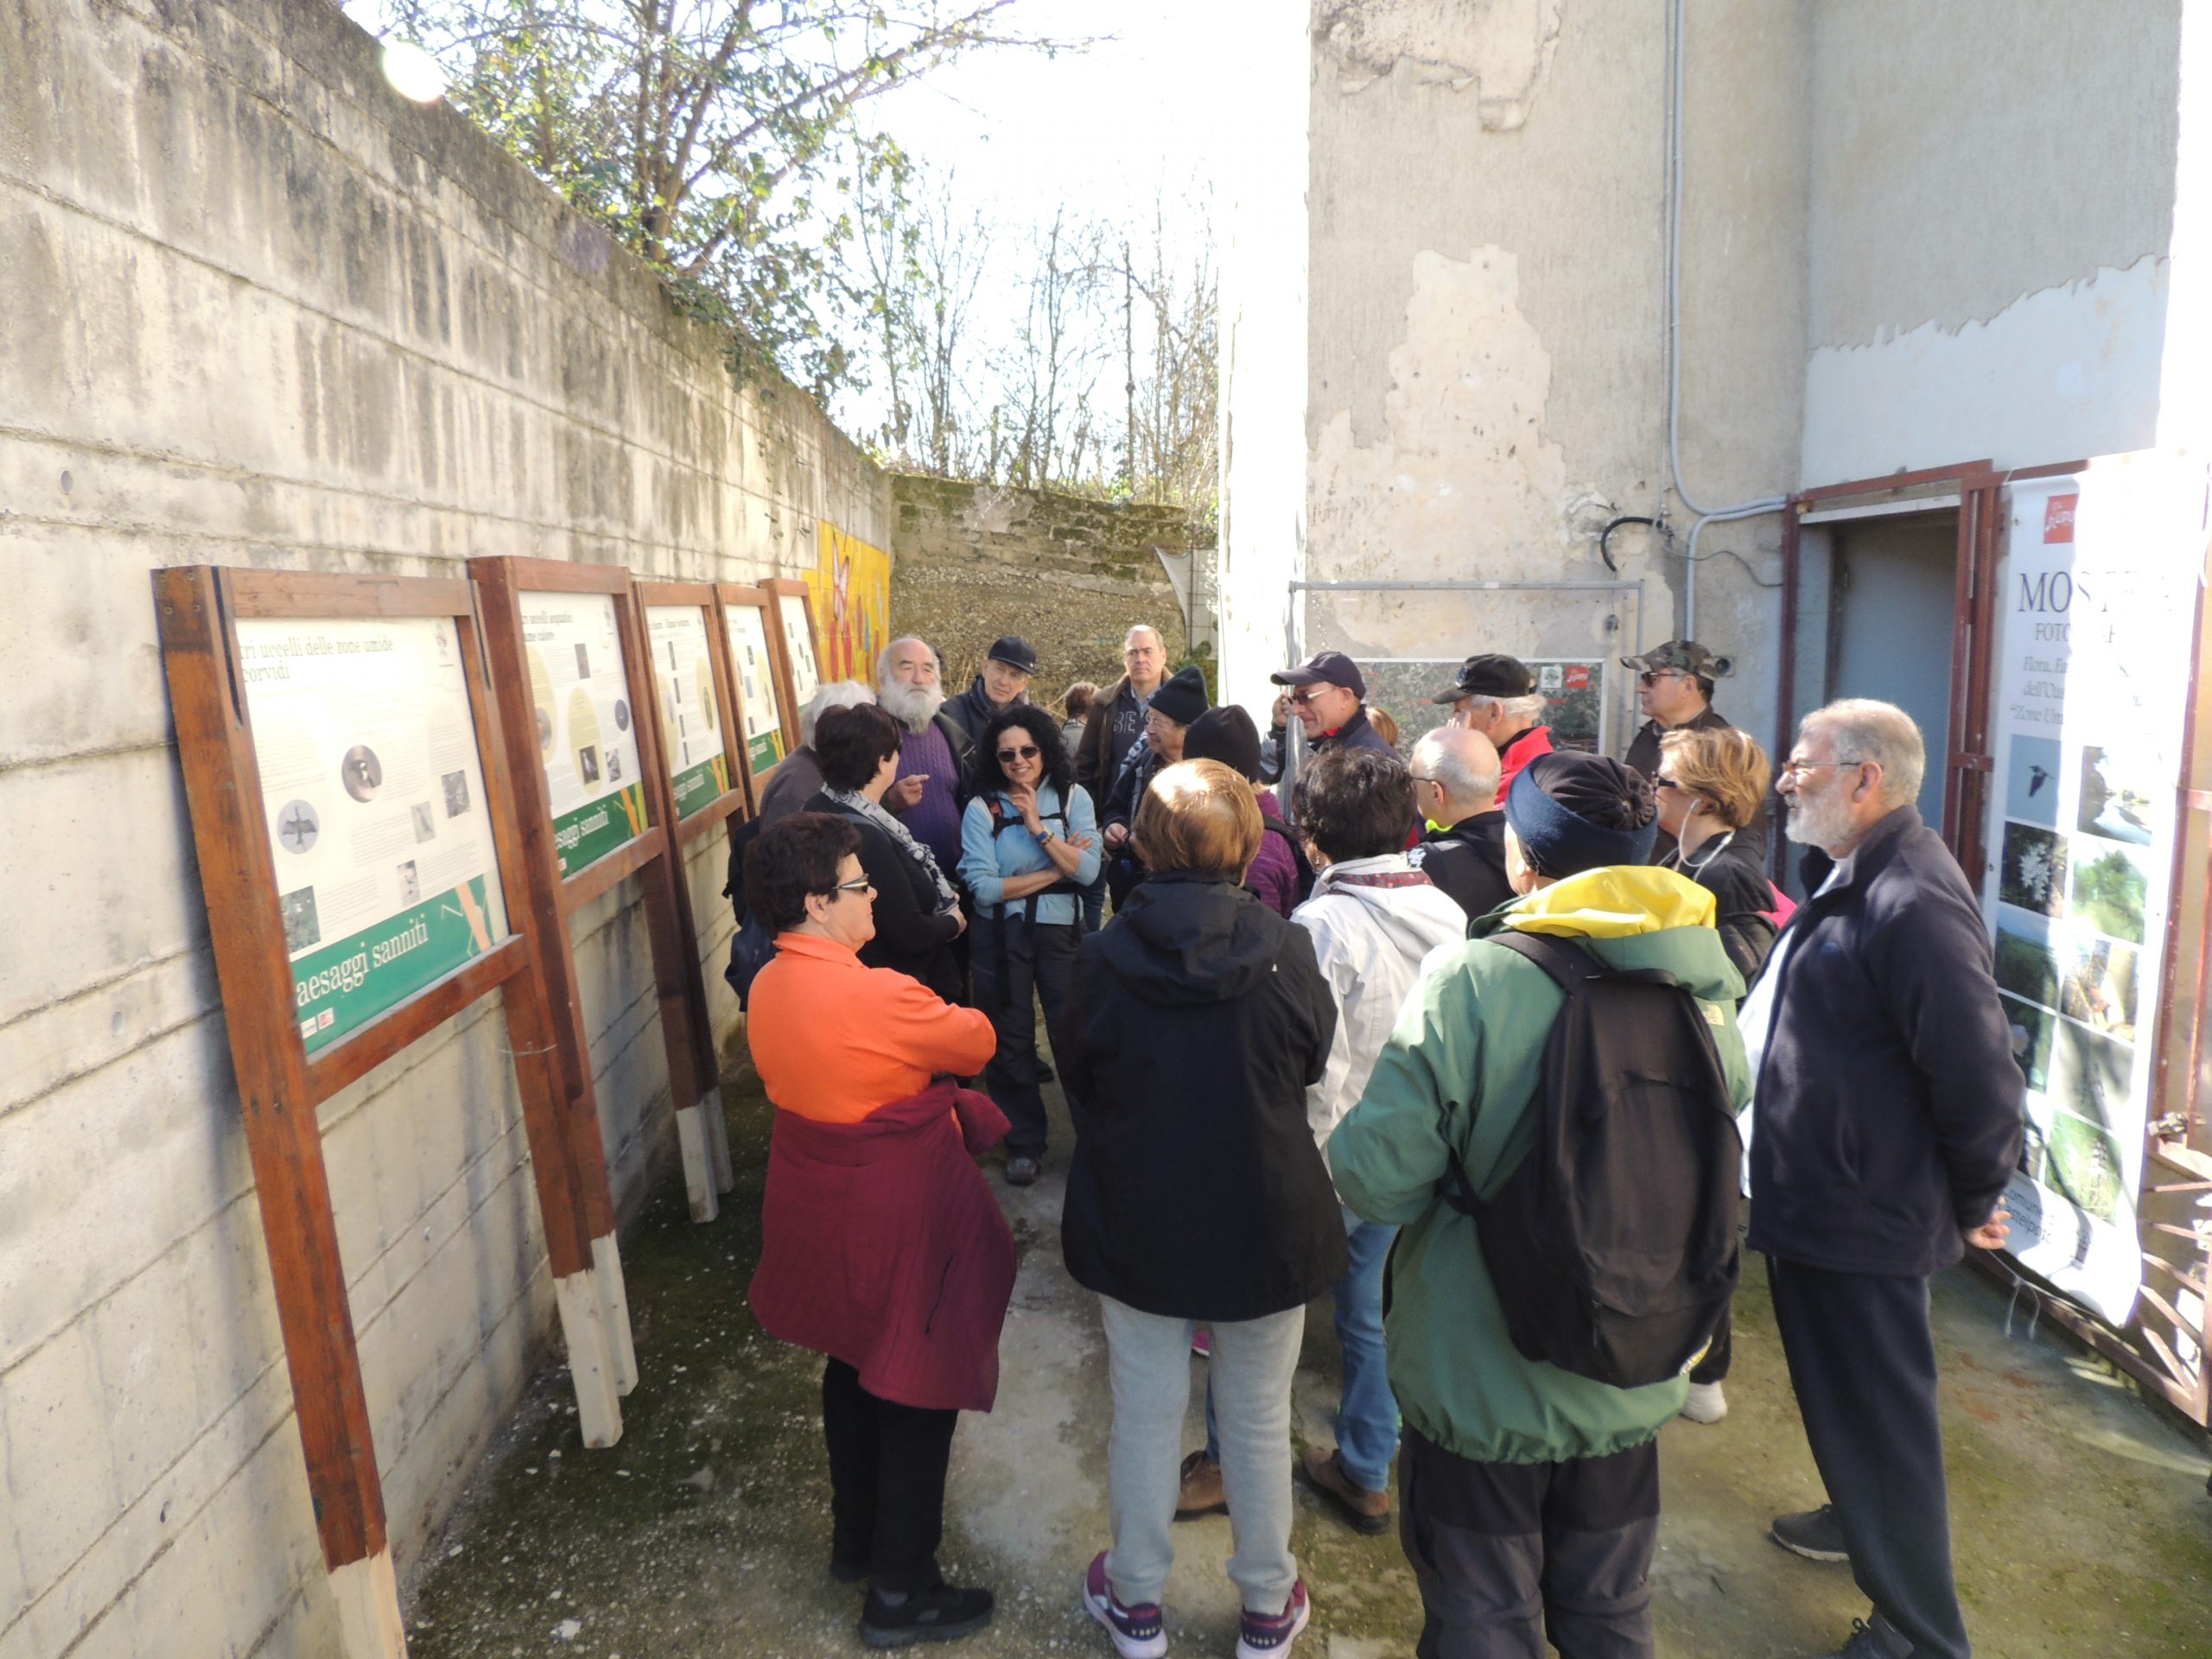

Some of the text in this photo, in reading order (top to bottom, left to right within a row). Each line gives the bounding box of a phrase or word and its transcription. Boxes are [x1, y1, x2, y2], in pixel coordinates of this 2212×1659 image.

[259, 637, 303, 658] uccelli
[305, 636, 336, 657] delle
[337, 639, 362, 655] zone
[363, 637, 394, 653] umide
[372, 912, 429, 963] sanniti
